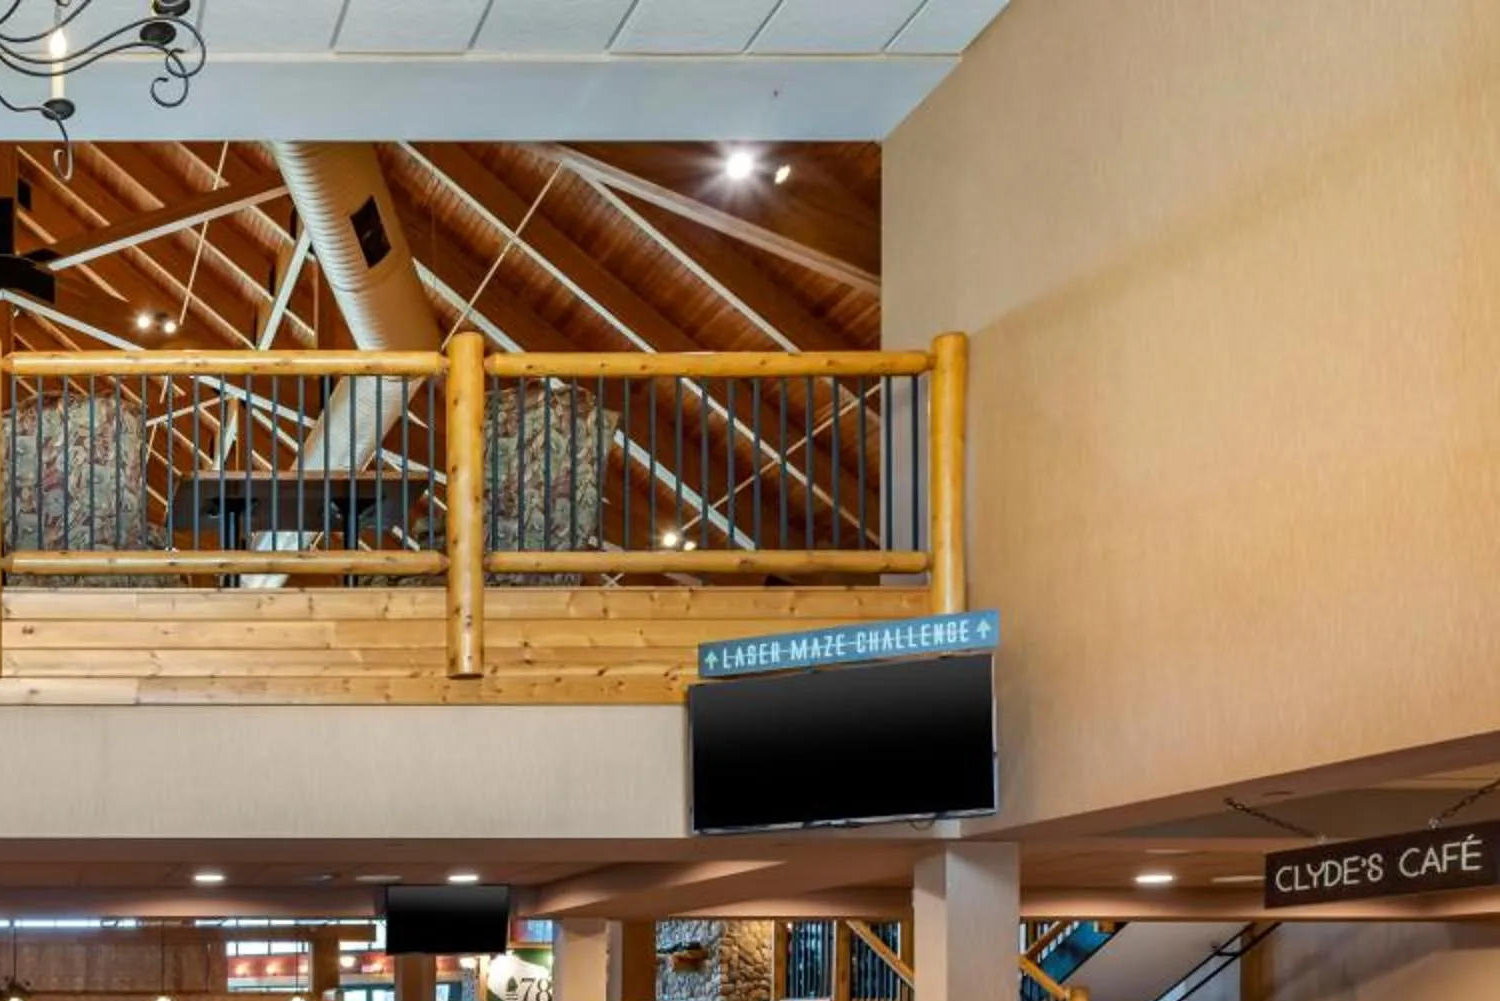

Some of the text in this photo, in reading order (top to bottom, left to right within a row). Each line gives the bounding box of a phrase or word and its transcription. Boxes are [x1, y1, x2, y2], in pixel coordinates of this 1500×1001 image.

[722, 619, 970, 669] LASER MAZE CHALLENGE
[1274, 833, 1483, 892] CLYDE'S CAFÉ
